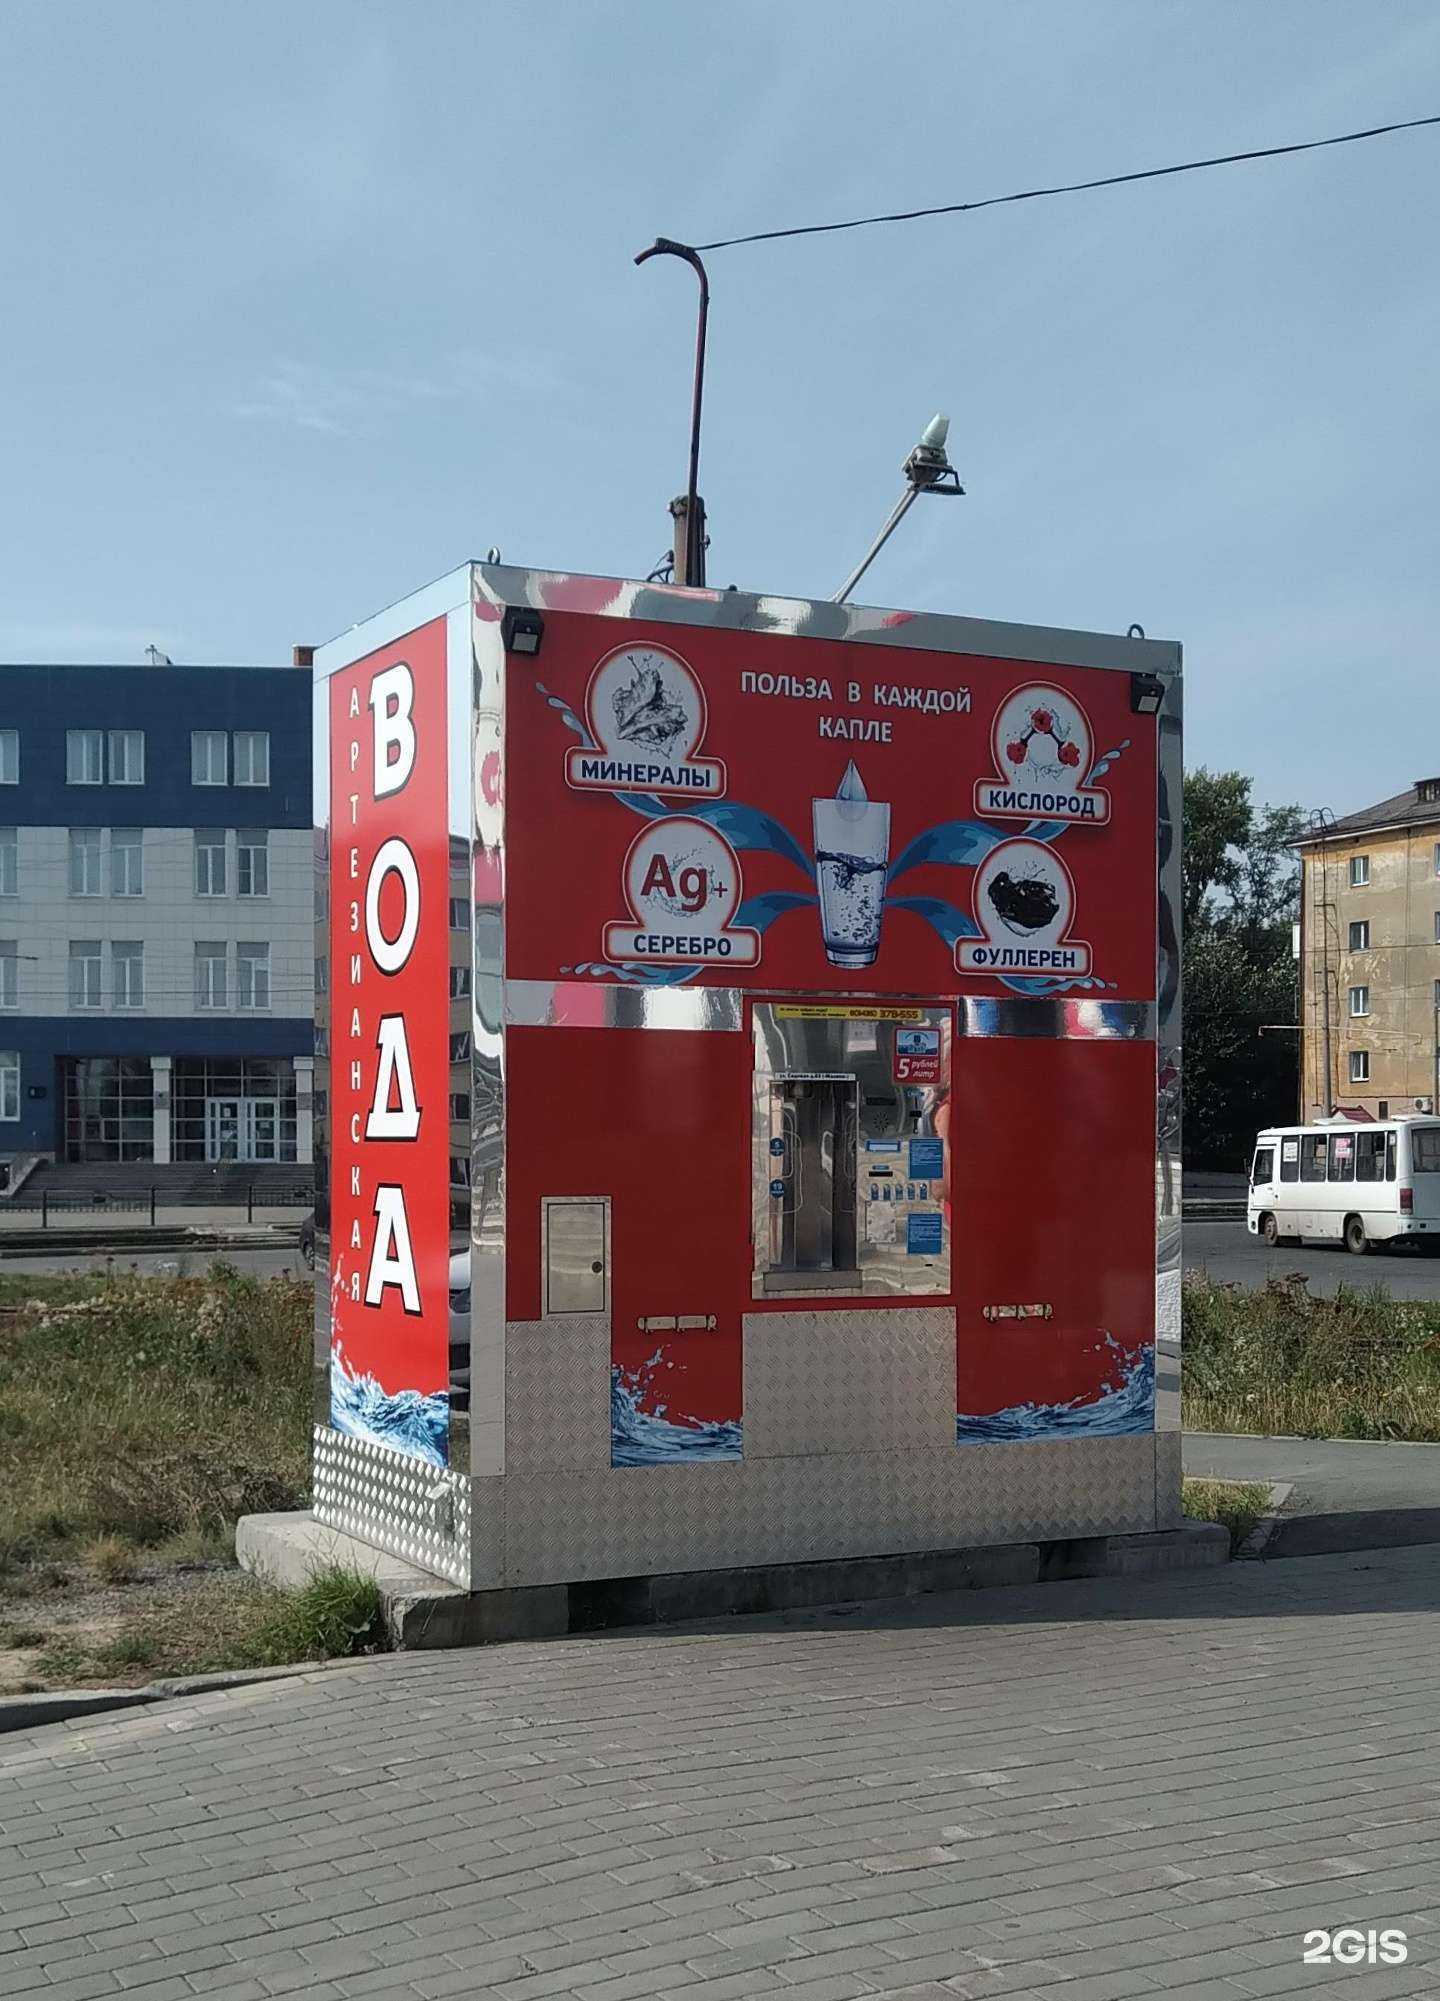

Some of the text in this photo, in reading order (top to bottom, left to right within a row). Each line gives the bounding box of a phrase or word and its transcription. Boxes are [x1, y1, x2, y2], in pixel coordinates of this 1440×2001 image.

[741, 671, 971, 714] ПОЛЬЗА В КАЖДОЙ
[819, 716, 893, 742] КАПЛЕ
[581, 759, 711, 788] МИНЕРАЛЫ
[989, 790, 1096, 818] КИСЛОРОД
[633, 934, 732, 956] СЕРЕБРО
[972, 948, 1075, 968] ФУЛЛЕРЕН
[349, 687, 361, 1302] АРТЕЗИАНСКАЯ
[364, 660, 423, 1318] ВОДА
[897, 1058, 939, 1079] 5 рублей
[912, 1071, 935, 1080] литр
